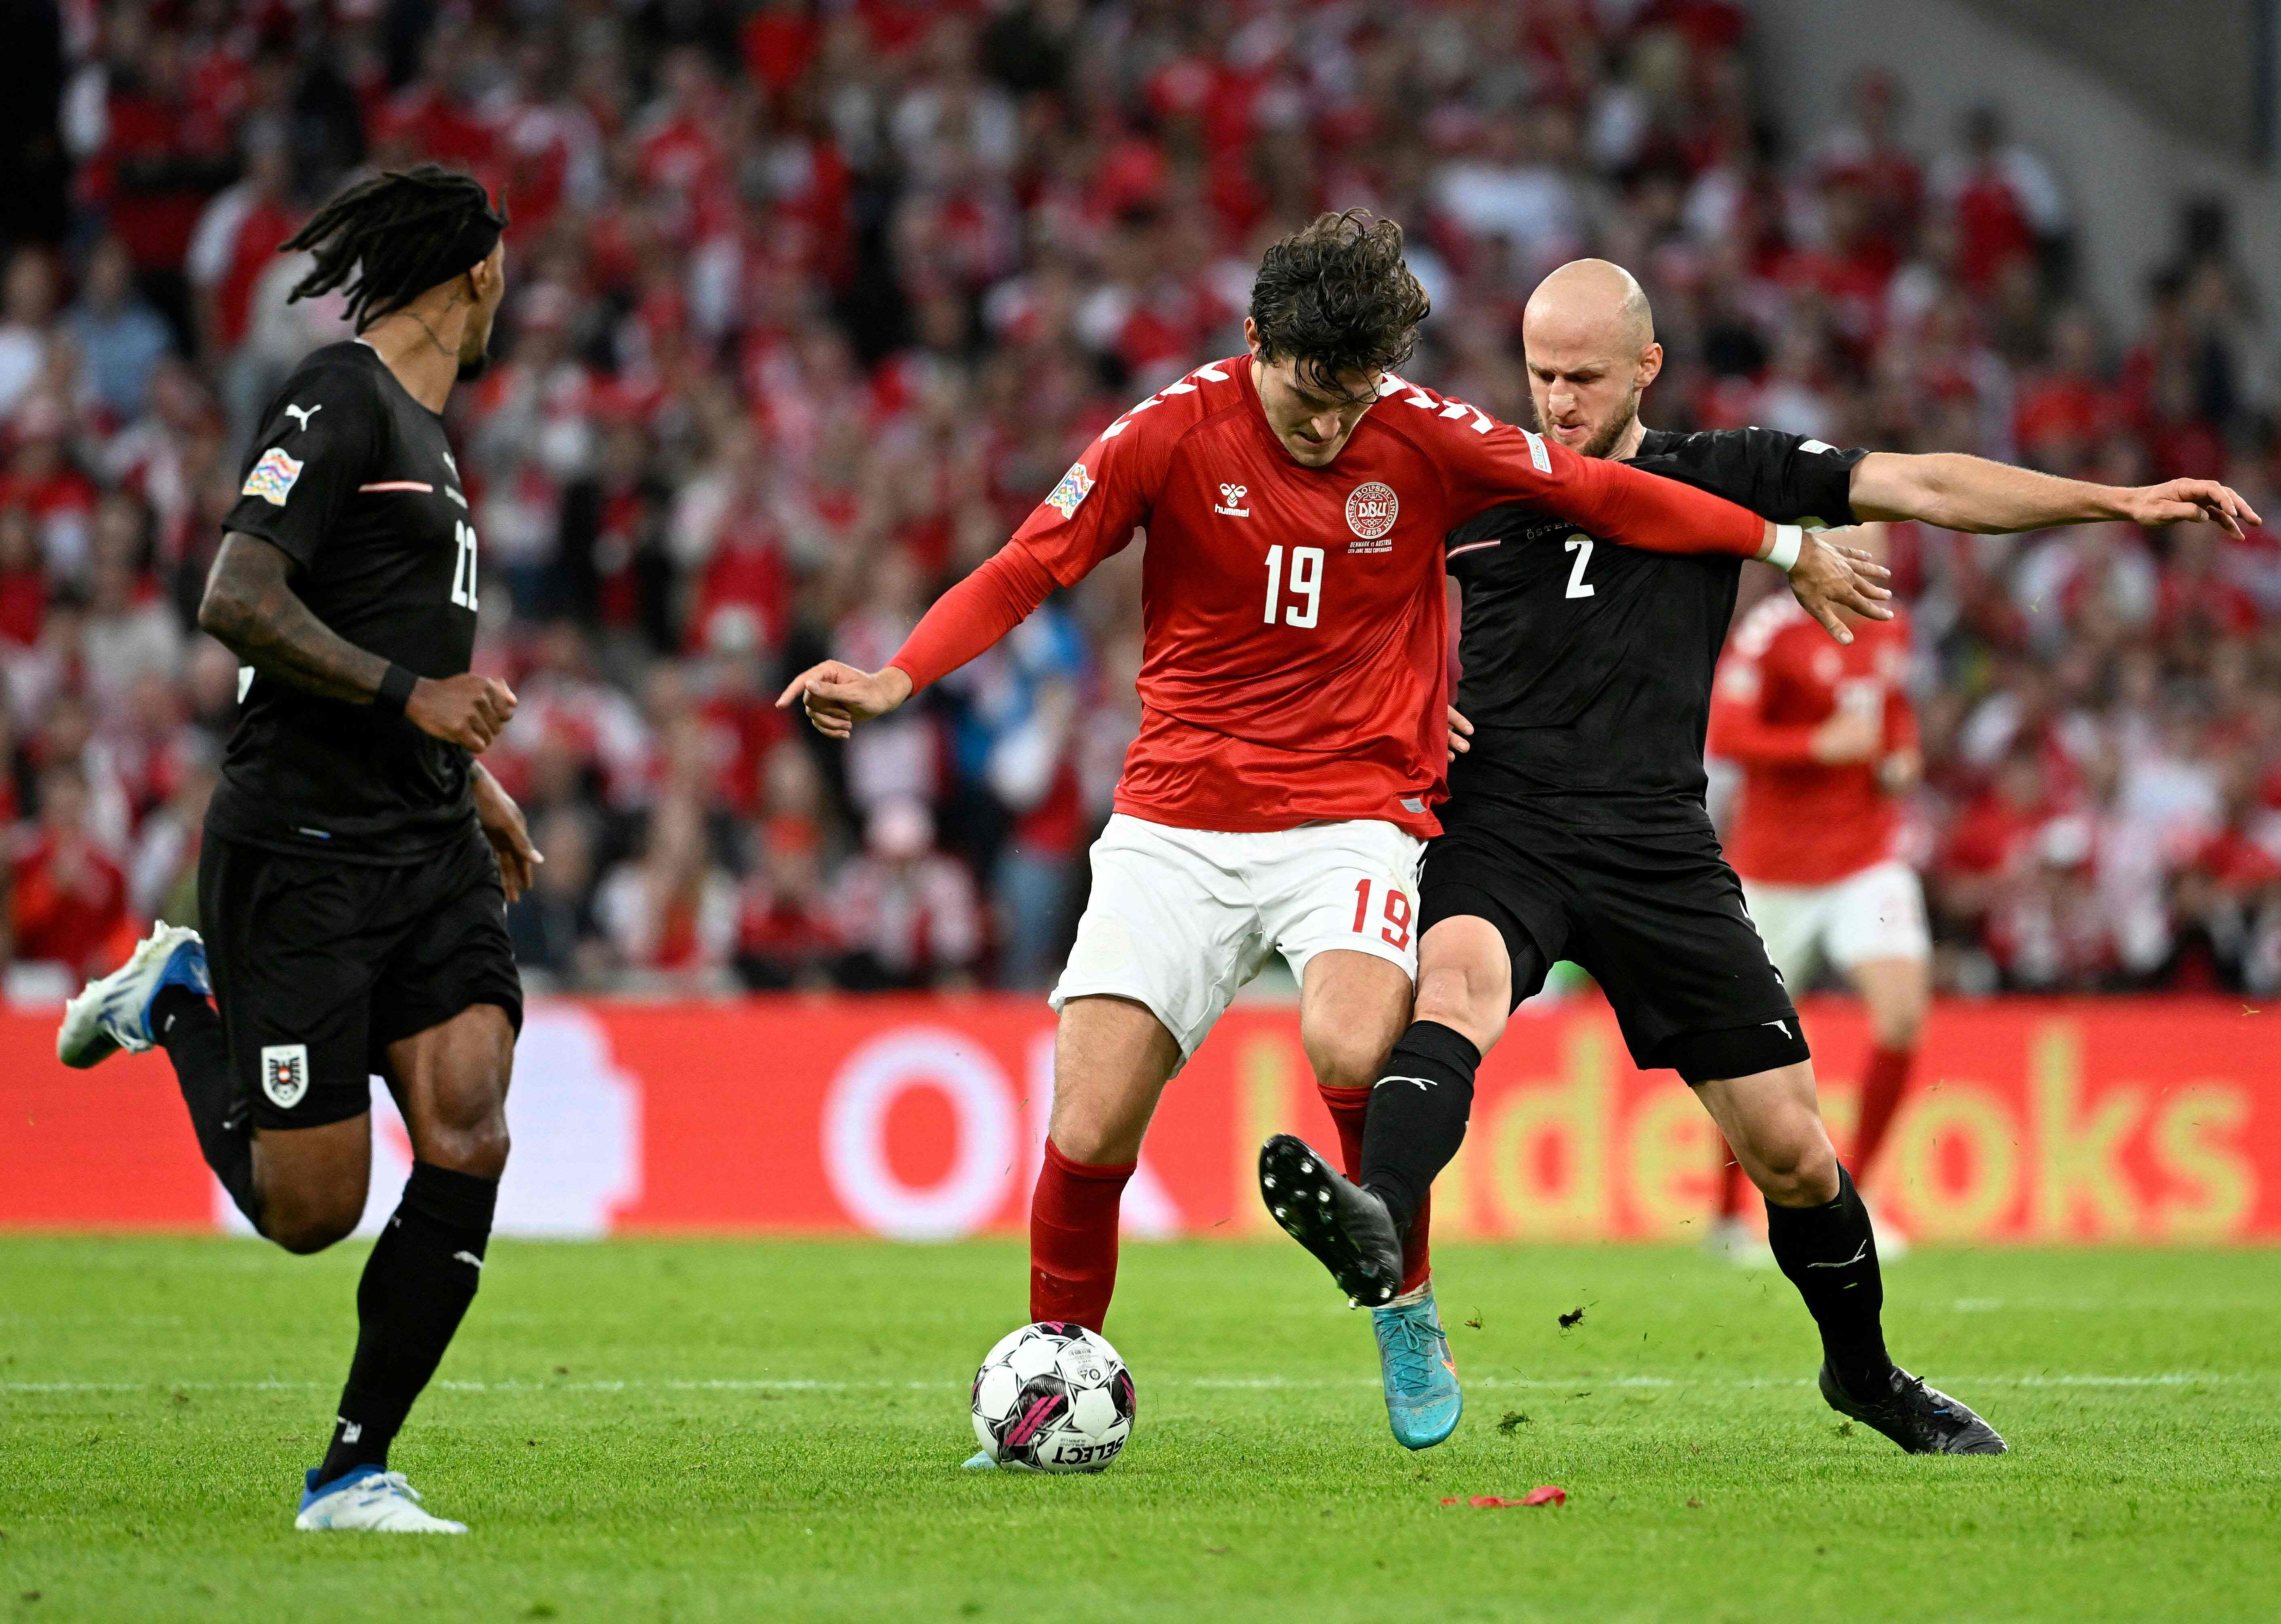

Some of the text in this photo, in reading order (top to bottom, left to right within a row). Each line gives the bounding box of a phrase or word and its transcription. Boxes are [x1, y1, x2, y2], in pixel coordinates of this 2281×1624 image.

[1215, 503, 1250, 517] hummel
[1349, 499, 1361, 531] DANSK
[1358, 501, 1387, 518] DBU
[1362, 527, 1382, 536] 1889
[1565, 533, 1595, 599] 2
[1264, 544, 1325, 629] 19
[1353, 879, 1411, 952] 19
[1052, 1434, 1125, 1464] SELECT
